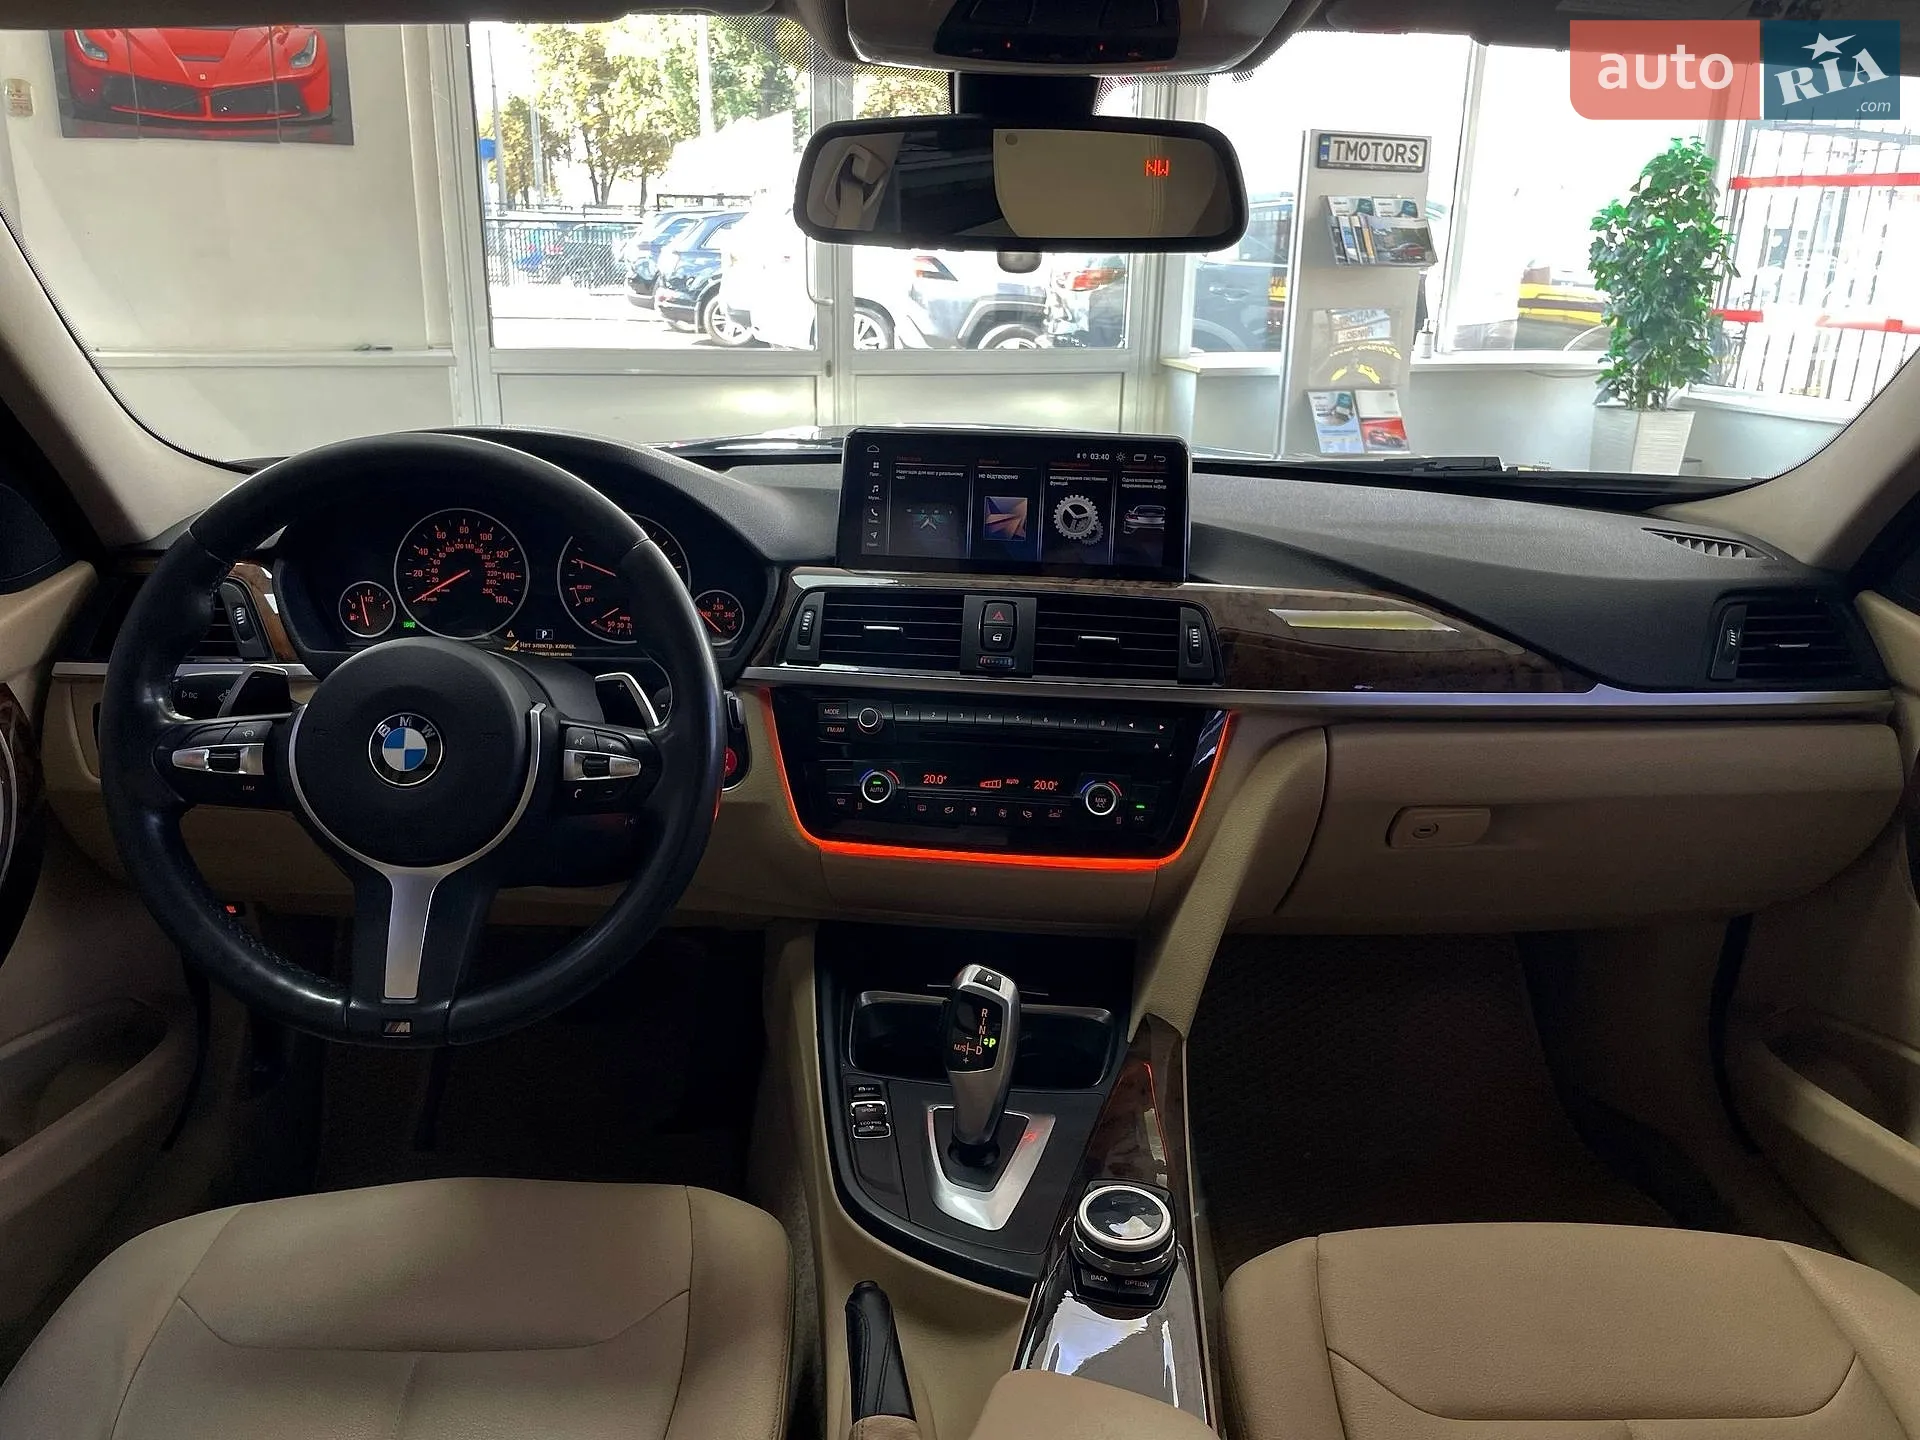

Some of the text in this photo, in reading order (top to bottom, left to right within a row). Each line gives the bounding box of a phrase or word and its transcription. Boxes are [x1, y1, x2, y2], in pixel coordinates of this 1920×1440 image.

[1333, 140, 1420, 163] TMOTORS
[1144, 159, 1169, 176] NW
[459, 526, 469, 534] 80
[479, 533, 492, 541] 100
[496, 550, 509, 558] 120
[413, 569, 423, 577] 20
[502, 572, 515, 580] 140
[495, 595, 508, 603] 160
[541, 630, 548, 639] P
[981, 1008, 988, 1018] R
[979, 1025, 986, 1035] N
[988, 1038, 996, 1048] P
[975, 1045, 983, 1056] D
[1124, 1279, 1150, 1288] OPTION
